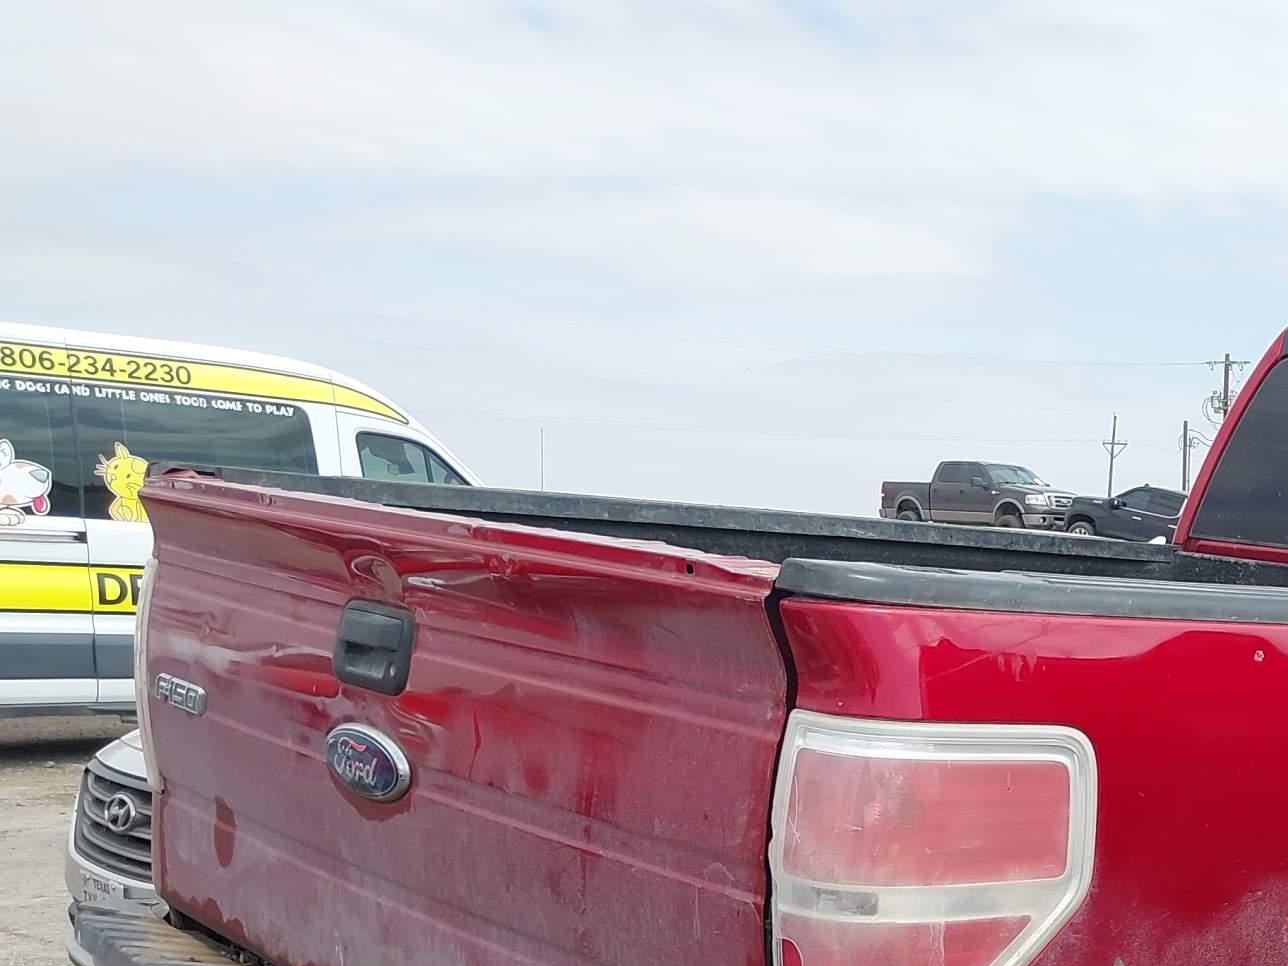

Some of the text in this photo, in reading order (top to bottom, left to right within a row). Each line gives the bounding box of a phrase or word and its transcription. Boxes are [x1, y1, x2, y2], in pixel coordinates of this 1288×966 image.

[0, 346, 192, 385] 806-234-2230
[94, 387, 136, 401] LITTLE
[211, 399, 243, 412] COME
[246, 402, 263, 413] TO
[265, 404, 295, 417] PLAY
[334, 736, 378, 786] Ford
[93, 879, 111, 895] TEXAS
